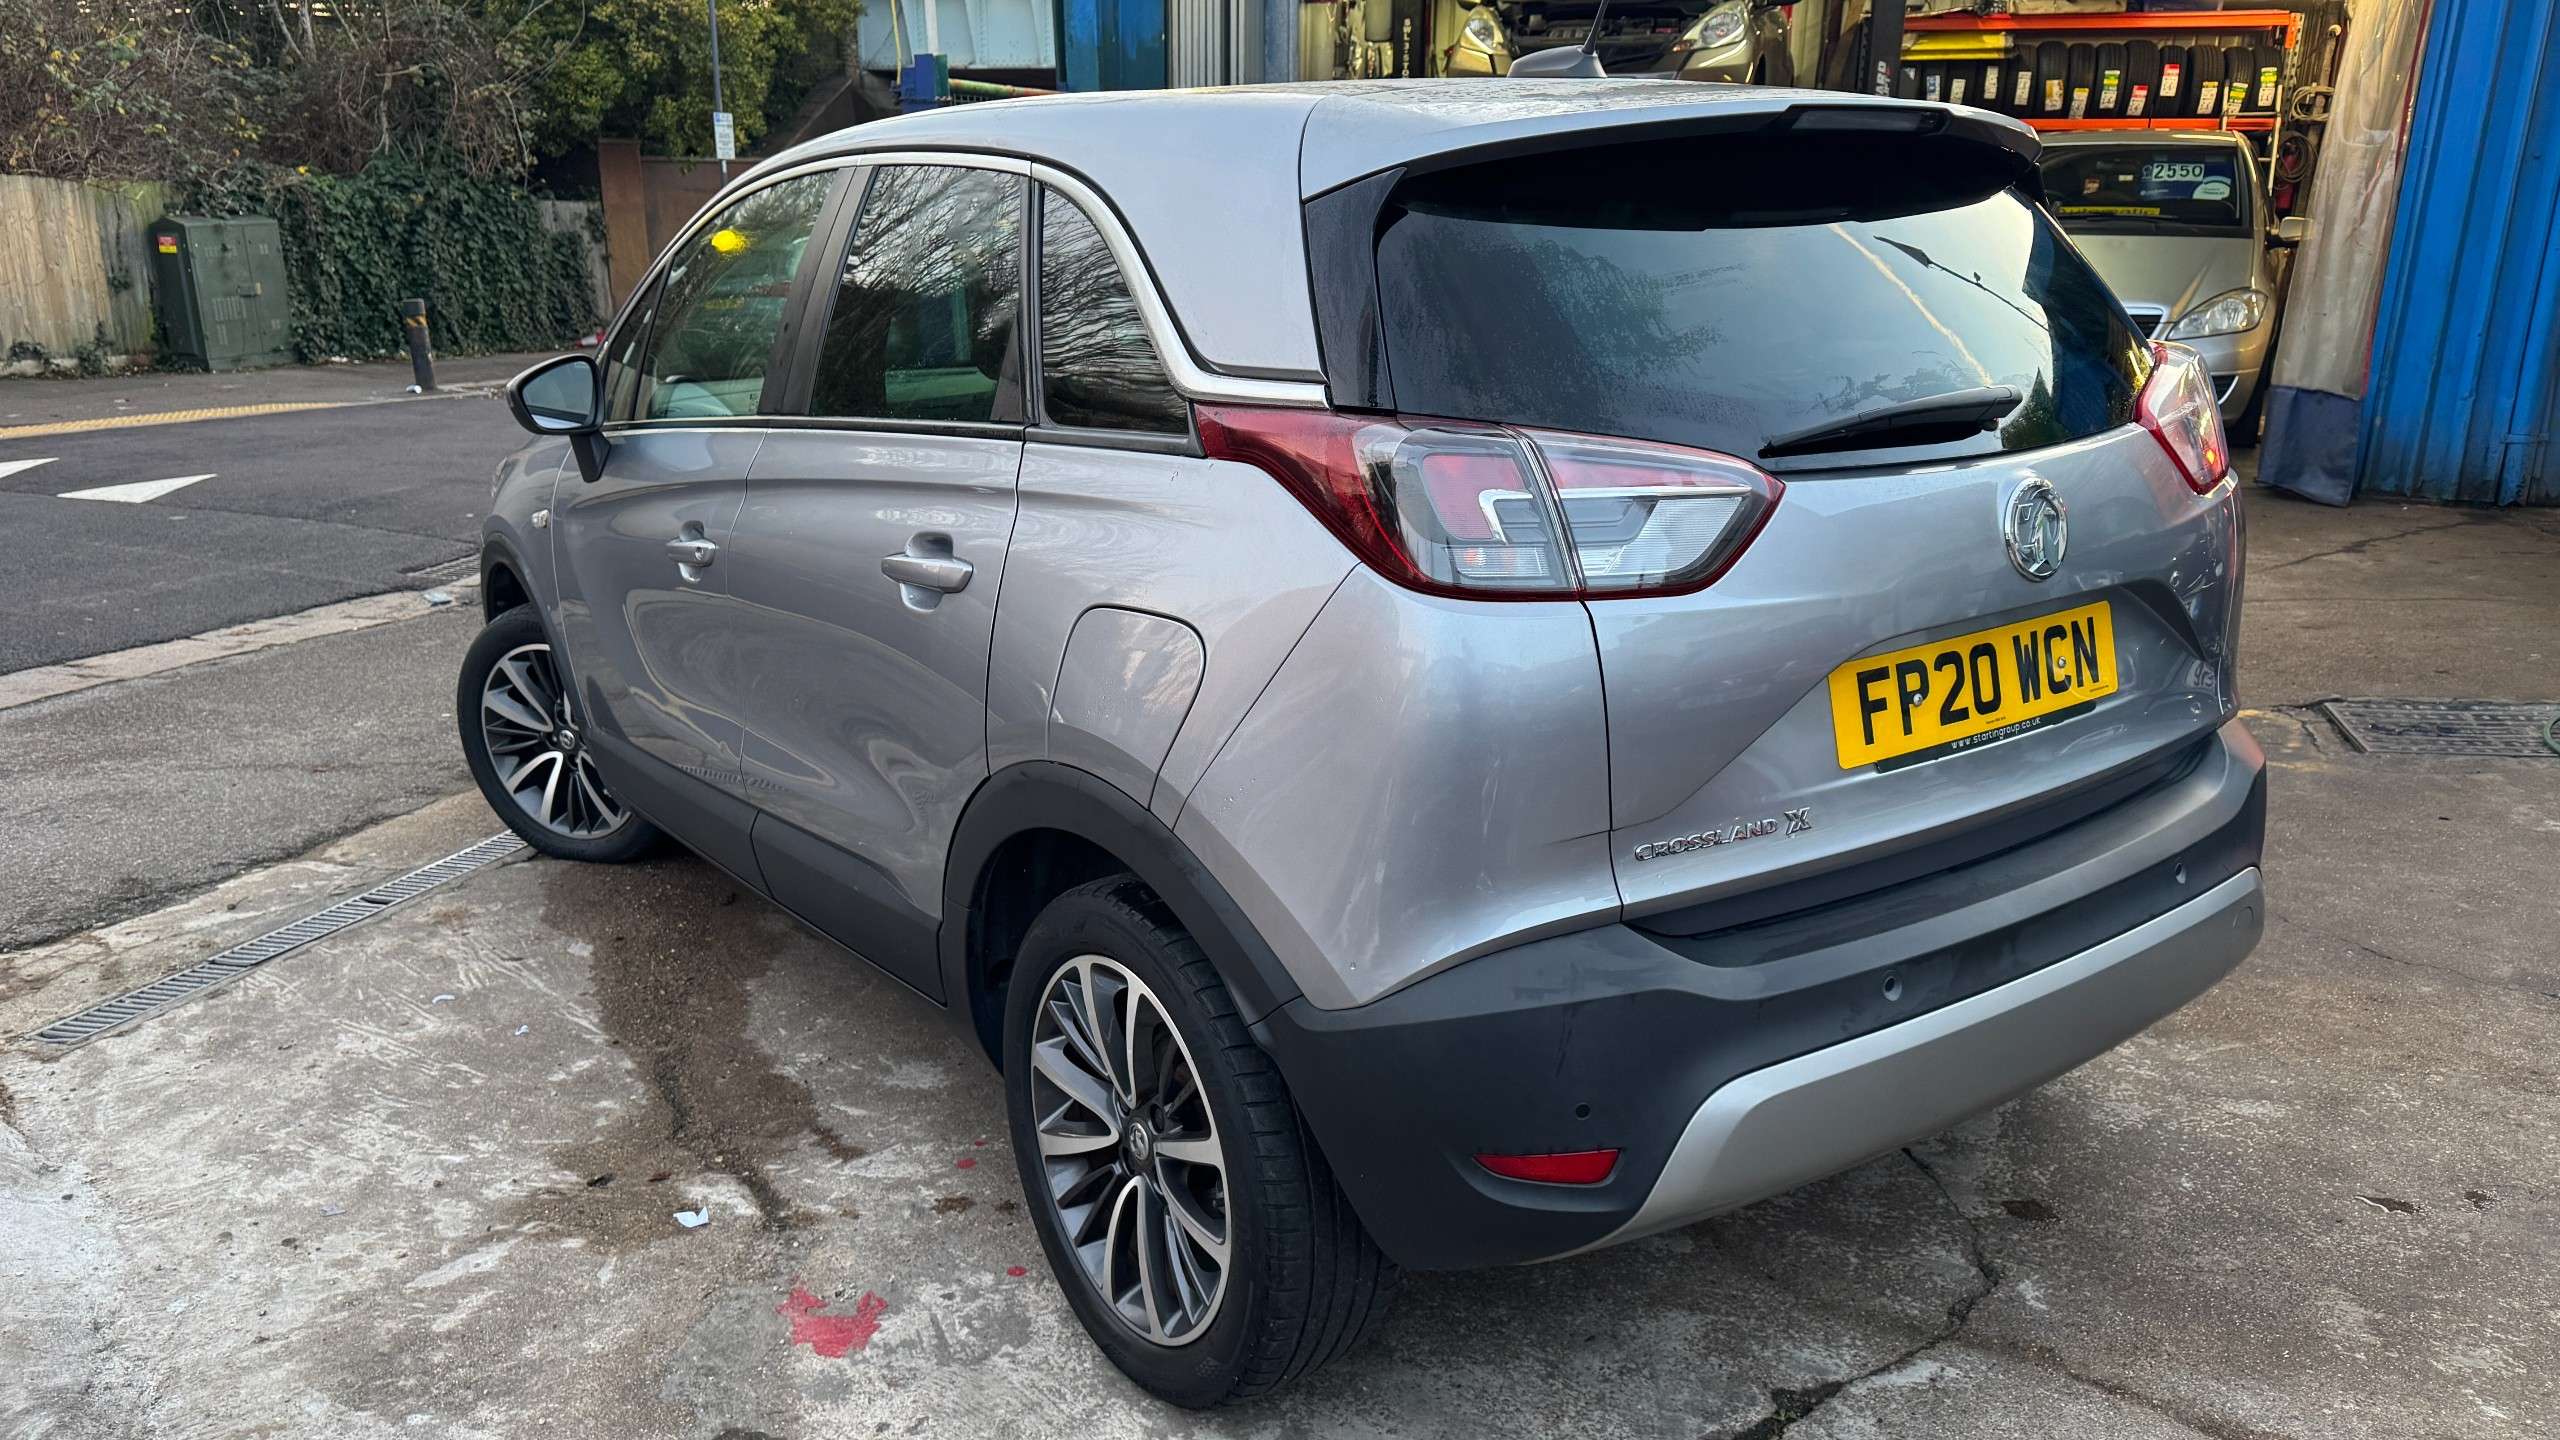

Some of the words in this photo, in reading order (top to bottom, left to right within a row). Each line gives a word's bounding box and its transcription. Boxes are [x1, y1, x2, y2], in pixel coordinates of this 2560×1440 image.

[1856, 642, 2001, 746] FP20
[2013, 616, 2101, 704] WCN
[1634, 818, 1778, 861] CROSSLAND
[1784, 806, 1812, 835] X
